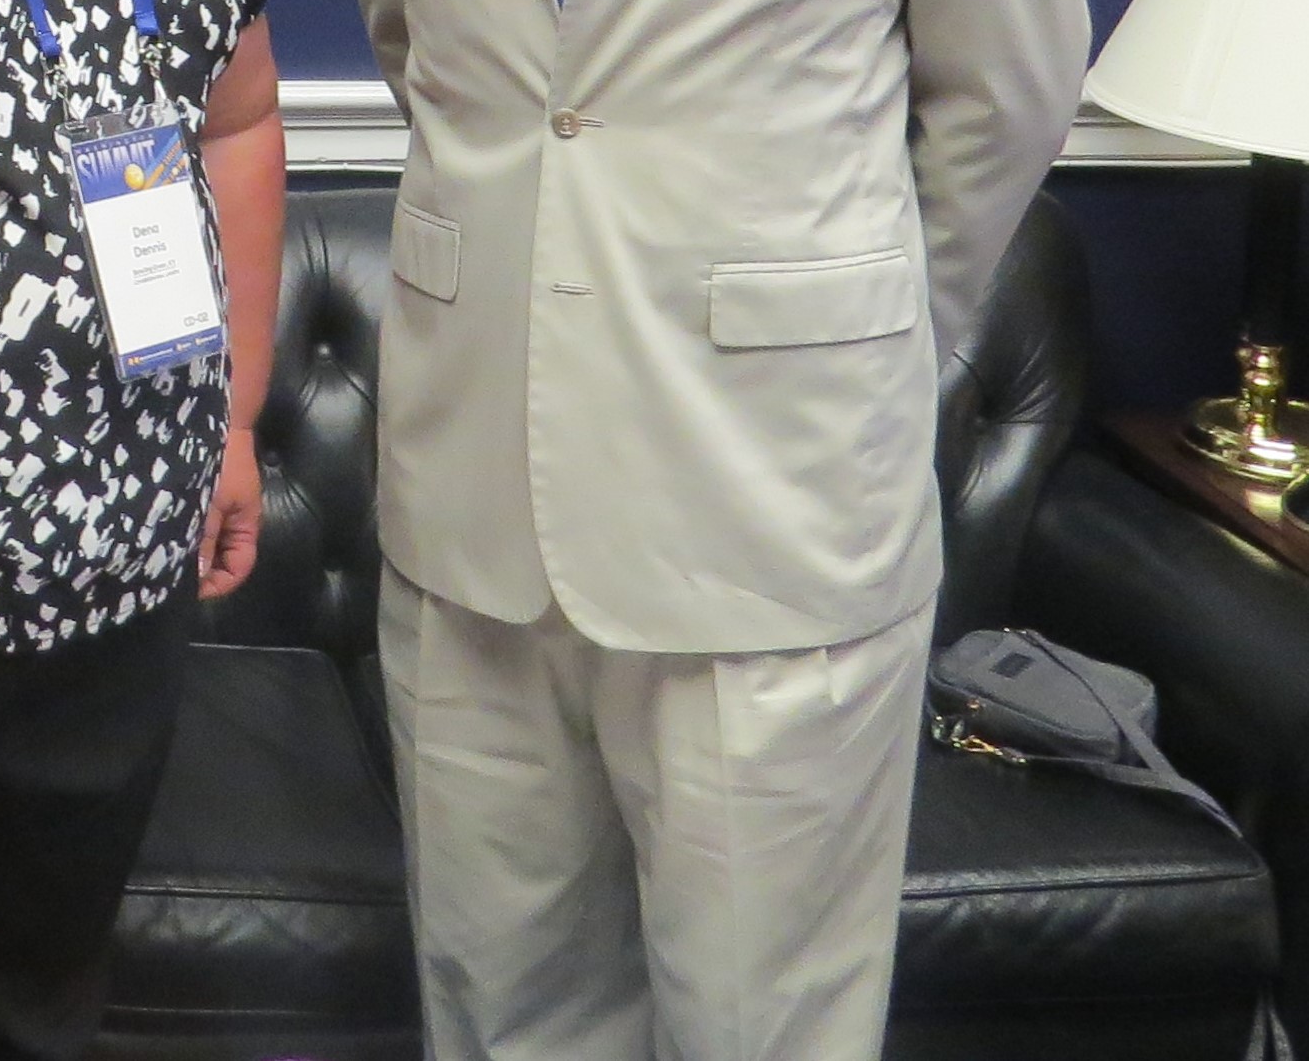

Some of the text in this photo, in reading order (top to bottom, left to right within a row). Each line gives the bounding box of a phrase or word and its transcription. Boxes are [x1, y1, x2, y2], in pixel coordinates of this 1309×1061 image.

[76, 139, 156, 183] SUMMIT
[132, 224, 160, 238] Dena
[133, 241, 167, 257] Dennis
